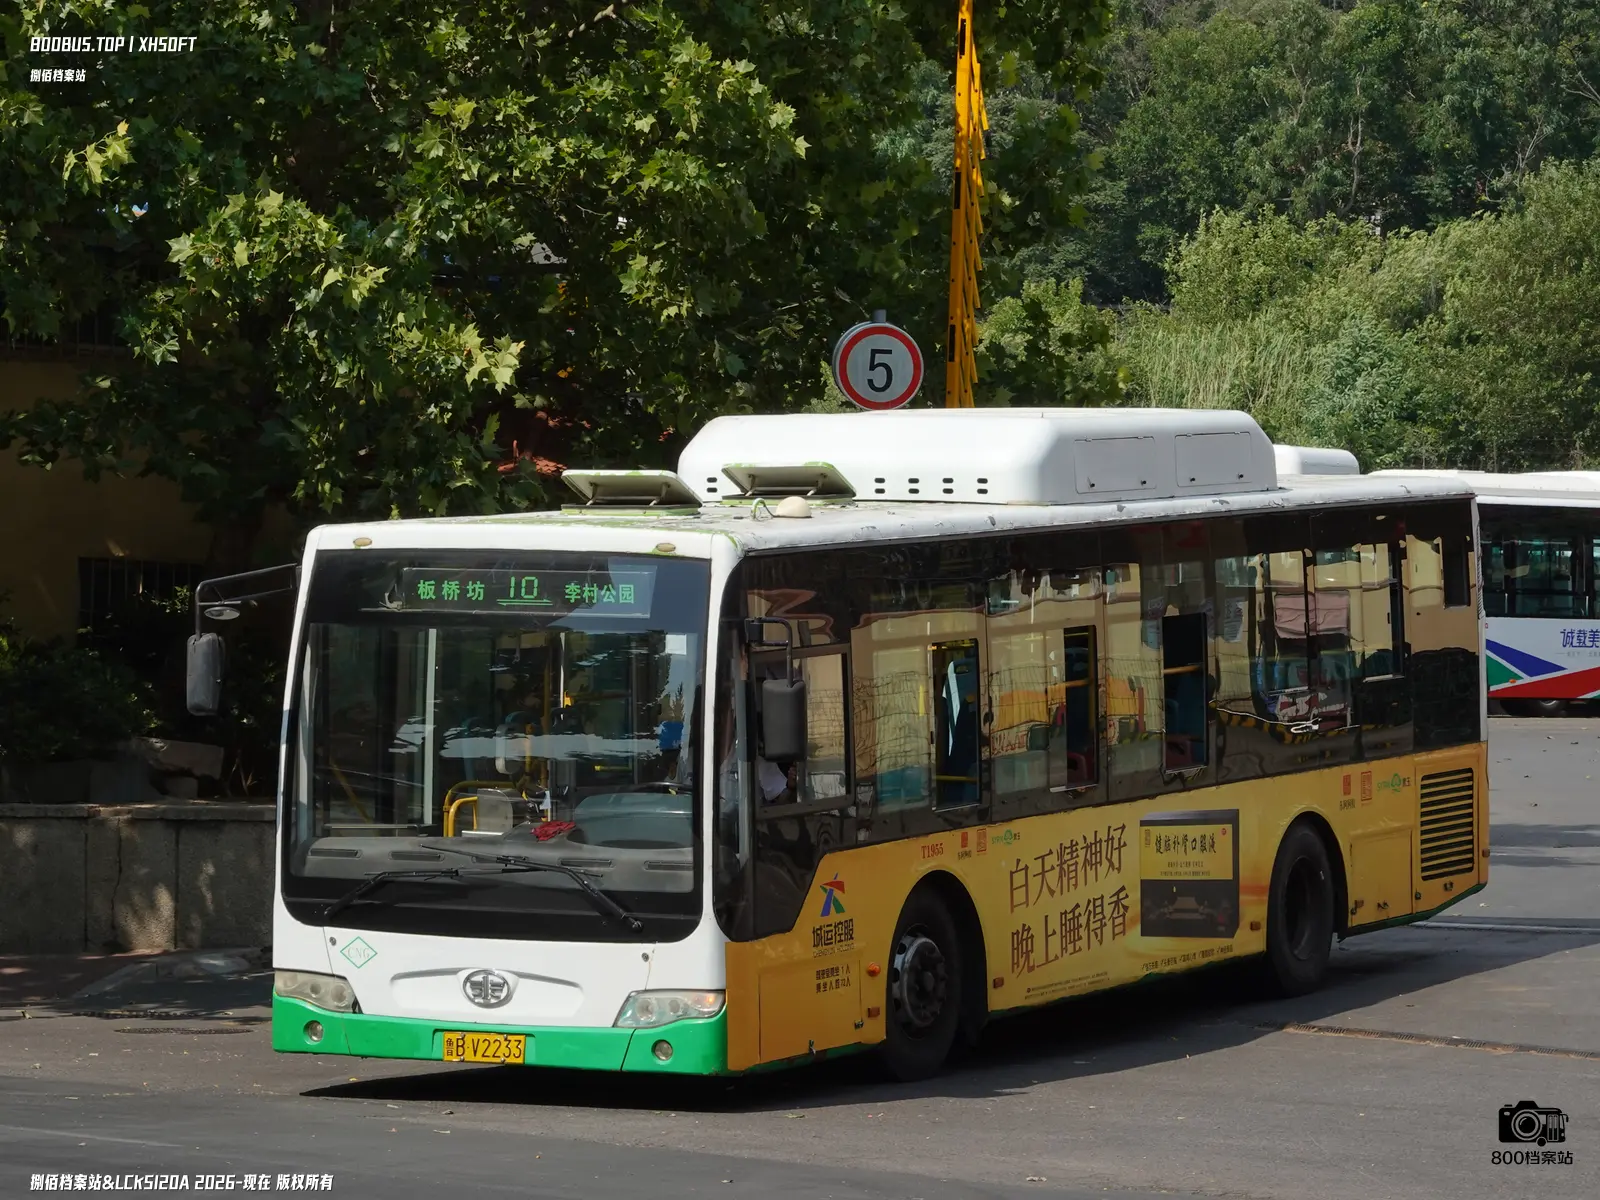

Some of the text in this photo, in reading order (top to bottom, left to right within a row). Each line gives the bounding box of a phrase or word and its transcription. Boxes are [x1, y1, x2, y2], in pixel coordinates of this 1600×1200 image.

[866, 348, 893, 393] 5
[417, 576, 635, 604] 板桥坊 10 李村公园
[921, 843, 944, 859] T1955
[1009, 823, 1128, 915] 白天精神好
[812, 918, 854, 948] 城运控股
[1010, 885, 1130, 978] 晚上睡得香
[347, 946, 370, 960] CNG
